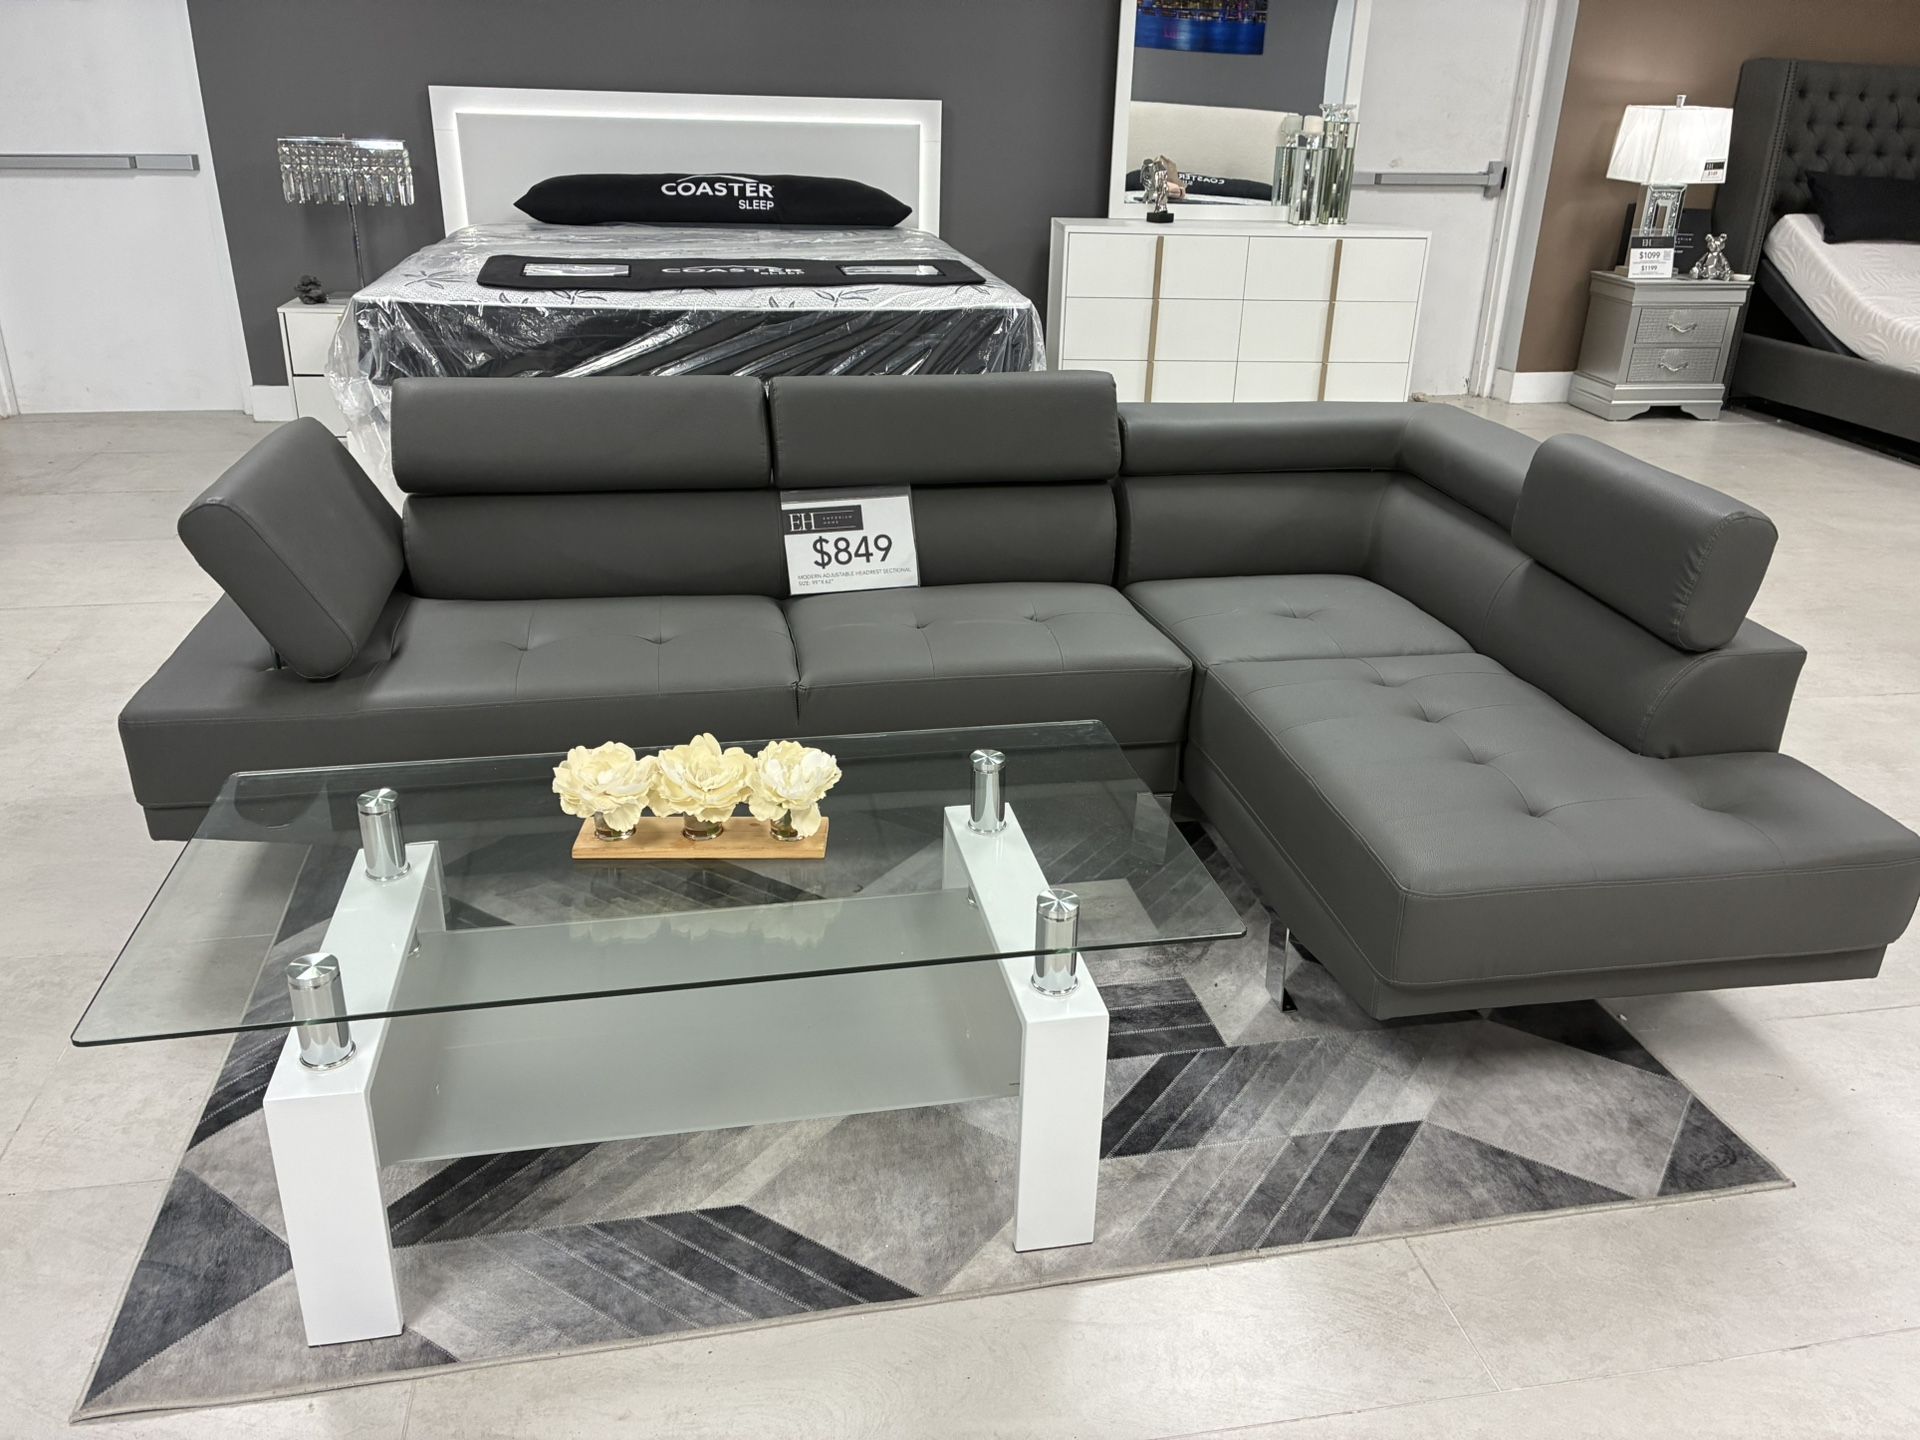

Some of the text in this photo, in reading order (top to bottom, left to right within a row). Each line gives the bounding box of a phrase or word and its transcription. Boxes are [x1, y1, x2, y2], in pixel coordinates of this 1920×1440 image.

[660, 182, 775, 198] COASTER
[738, 199, 775, 210] SLEEP
[1639, 251, 1661, 260] $1099
[789, 512, 815, 532] EH
[812, 534, 893, 569] $849
